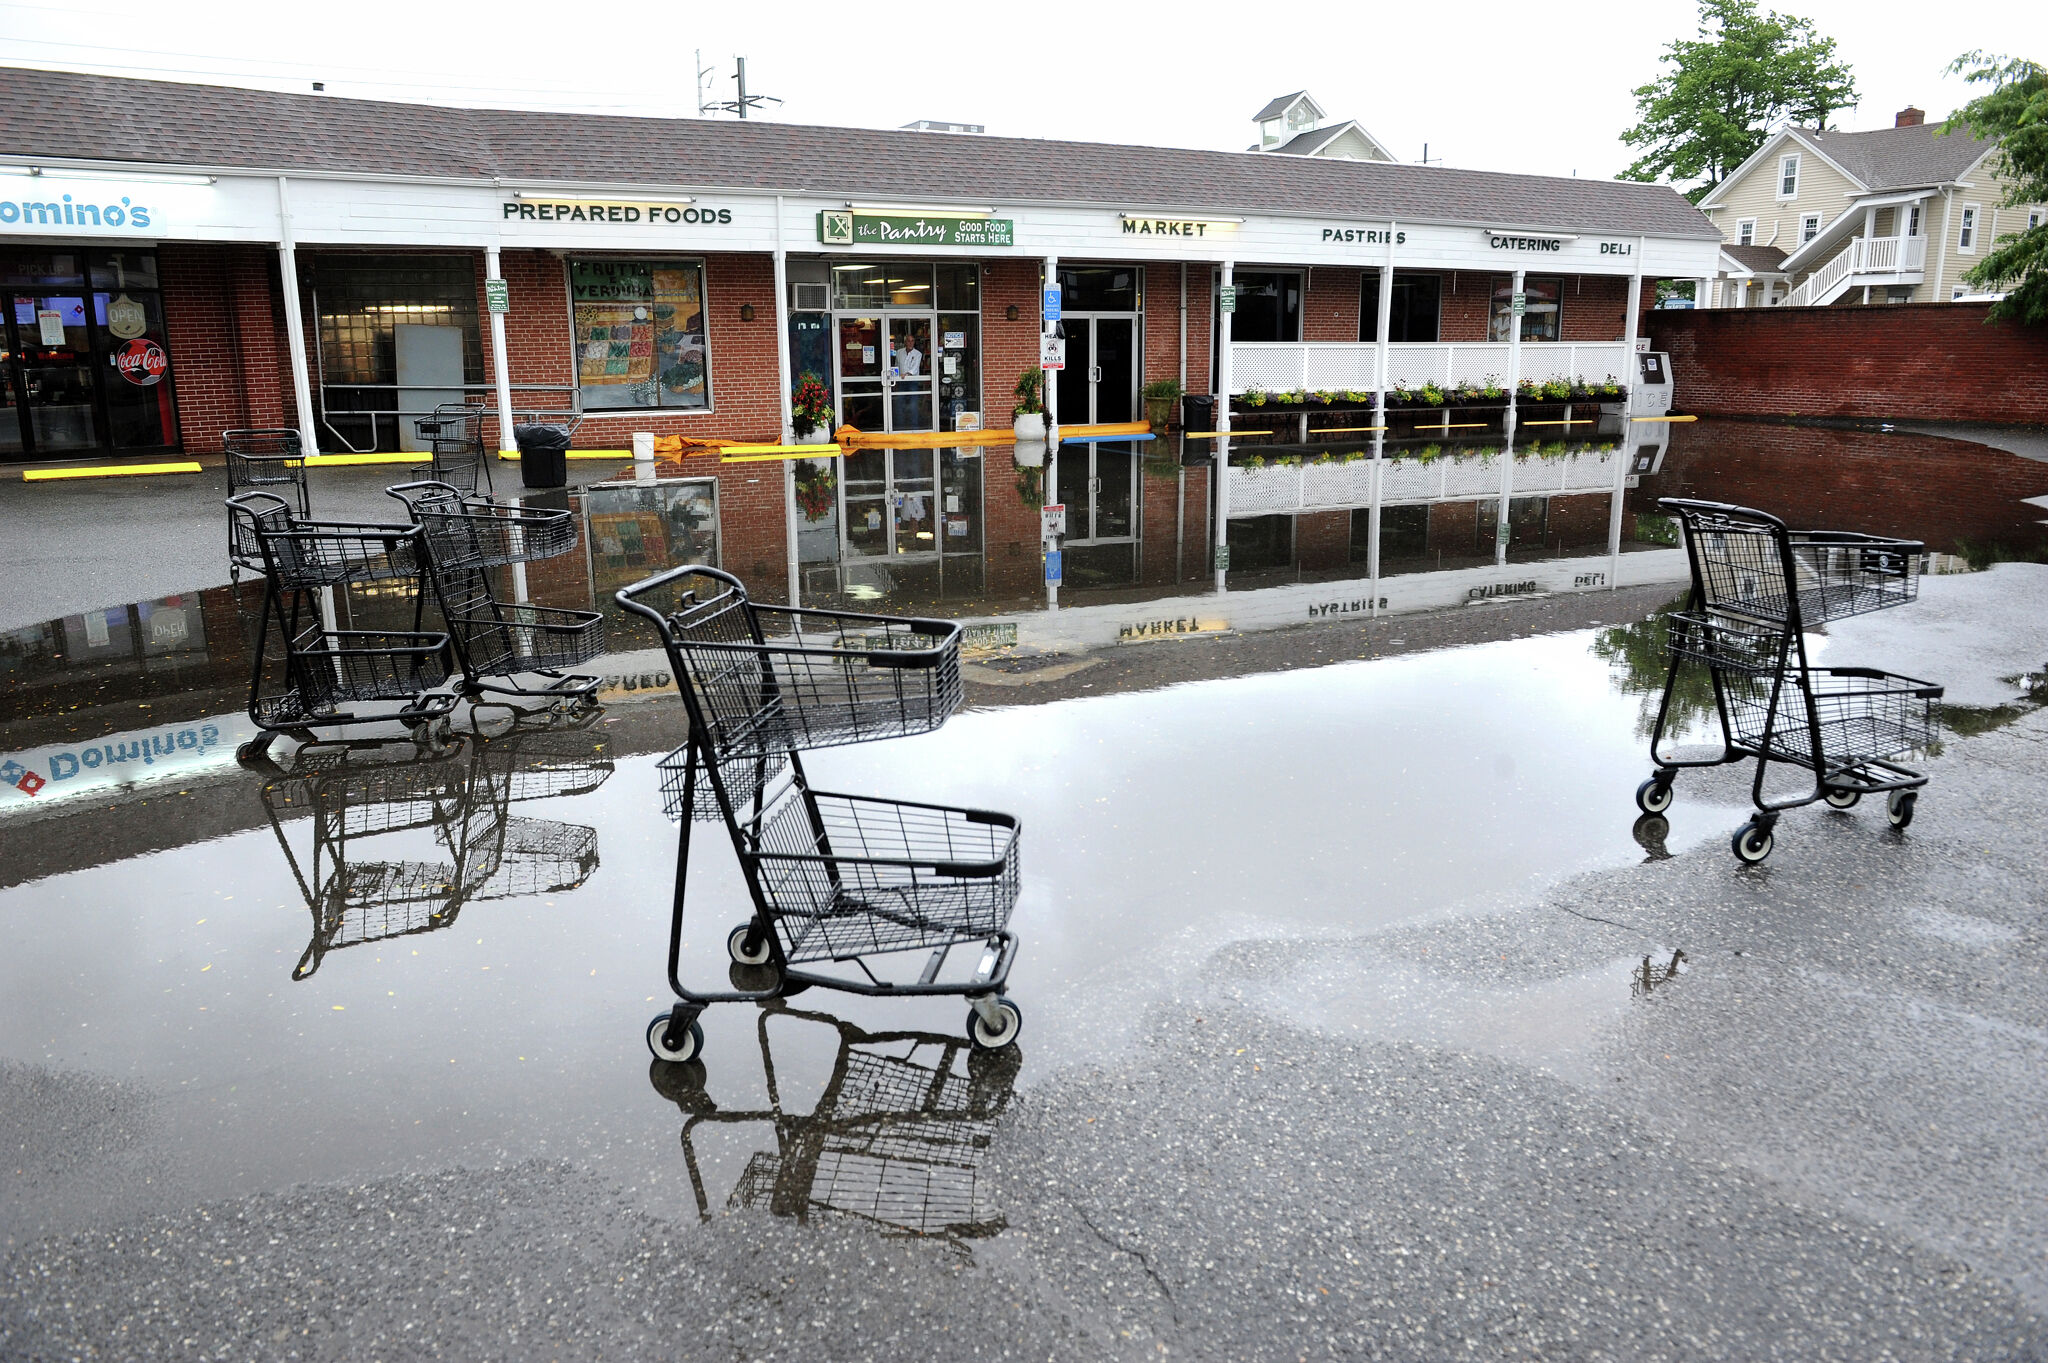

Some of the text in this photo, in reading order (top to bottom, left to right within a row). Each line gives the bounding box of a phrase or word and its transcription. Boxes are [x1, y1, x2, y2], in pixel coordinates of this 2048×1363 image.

[503, 203, 732, 224] PREPARED FOODS
[858, 219, 947, 242] the Pantry
[959, 221, 1006, 233] GOOD FOOD
[1122, 220, 1207, 236] MARKET
[955, 232, 1011, 243] STARTS HERE
[1322, 228, 1406, 244] PASTRIES
[1490, 236, 1561, 251] CATERING
[1600, 242, 1631, 256] DELI
[579, 262, 650, 277] FRUTTA
[109, 308, 145, 323] OPEN
[118, 347, 168, 371] Coca-Cola
